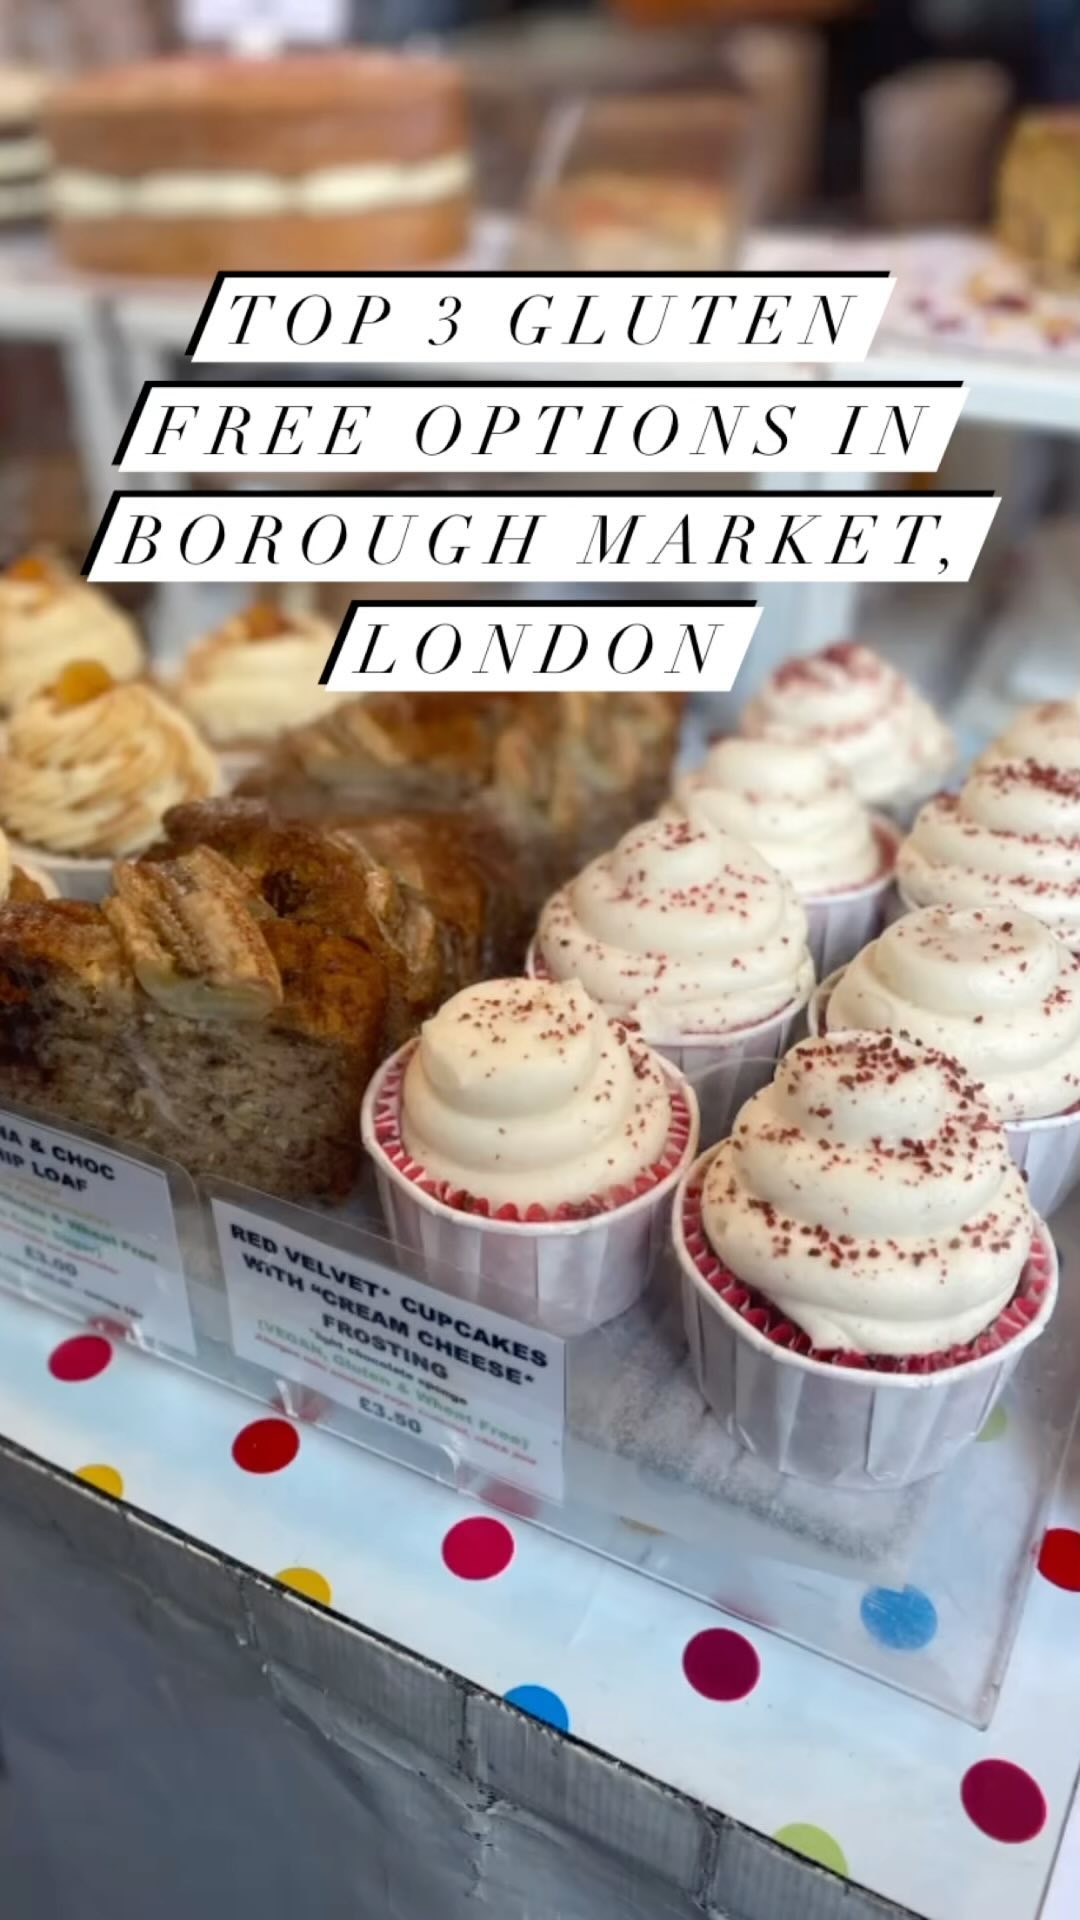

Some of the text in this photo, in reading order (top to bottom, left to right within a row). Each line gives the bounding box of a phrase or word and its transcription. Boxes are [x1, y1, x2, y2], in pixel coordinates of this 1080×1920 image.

[30, 1137, 46, 1154] &
[52, 1145, 116, 1181] CHOC
[32, 1161, 88, 1192] LOAF
[241, 1251, 305, 1292] WITH
[229, 1222, 278, 1255] RED
[401, 1295, 548, 1368] CUPCAKES
[321, 1312, 449, 1381] FROSTING
[358, 1395, 423, 1434] £3.50
